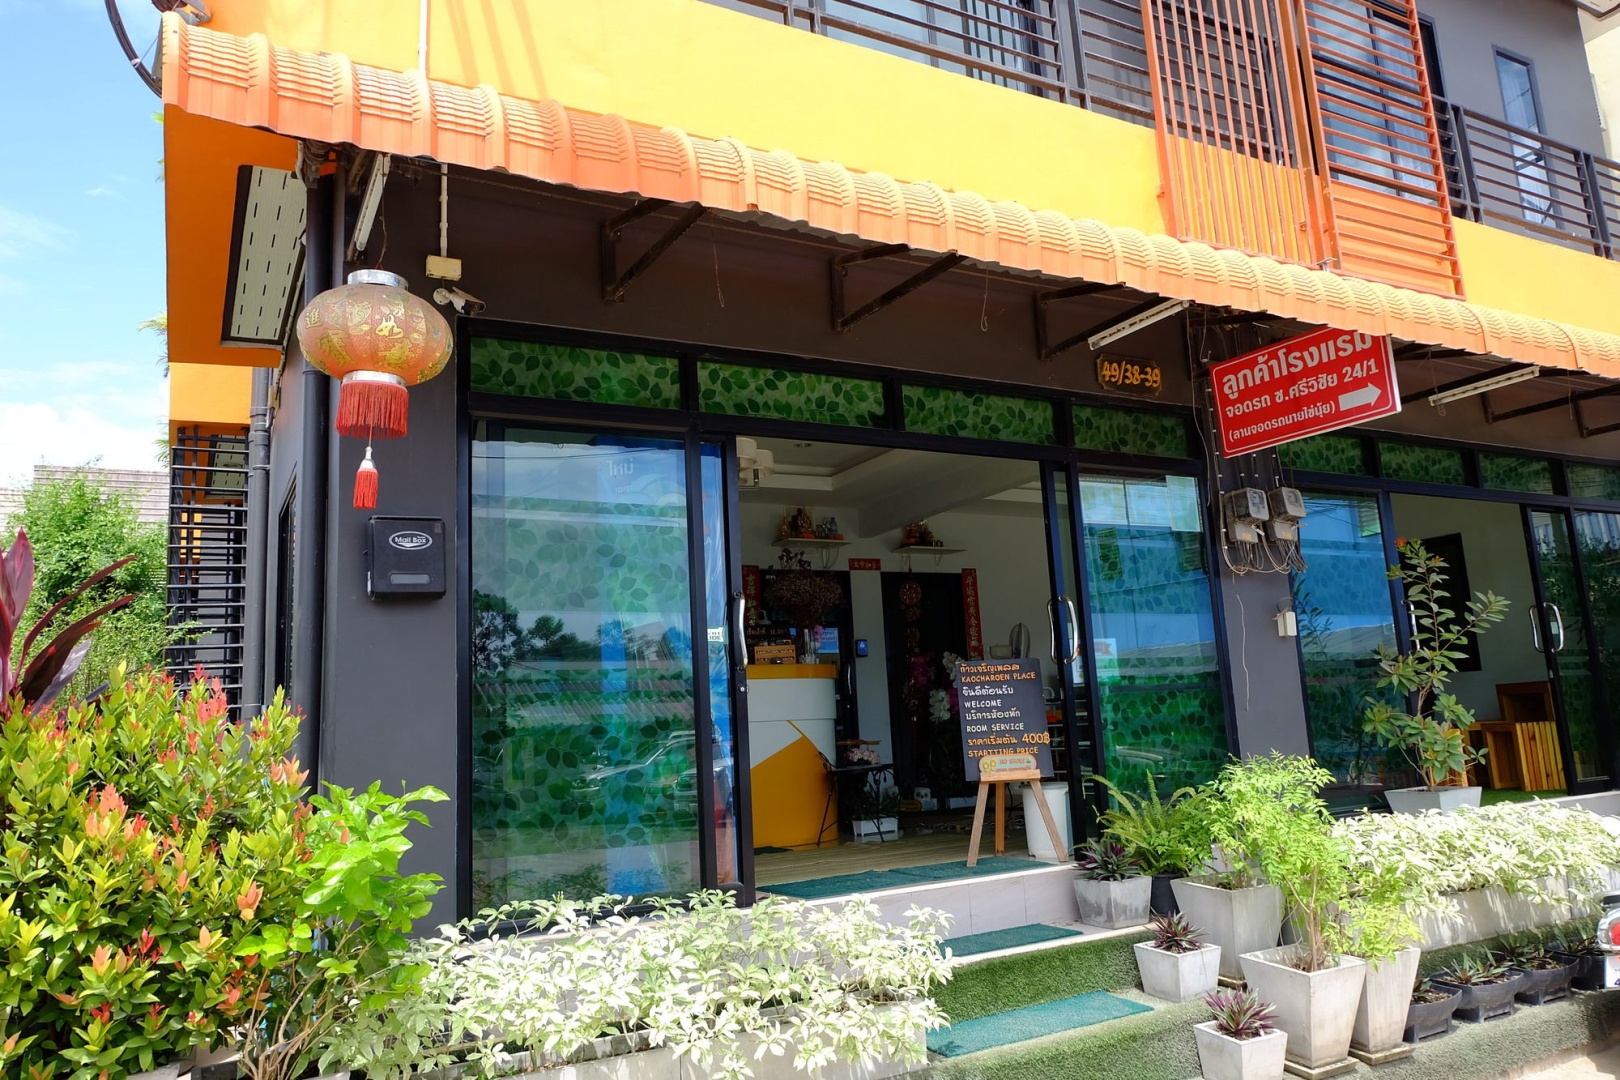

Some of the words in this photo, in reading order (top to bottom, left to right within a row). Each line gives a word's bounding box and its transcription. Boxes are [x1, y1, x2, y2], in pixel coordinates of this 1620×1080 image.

[1222, 332, 1373, 399] ลูกค้าโรงแรม
[1102, 361, 1161, 387] 49/38-39
[1225, 395, 1271, 418] จอดรถ
[1342, 358, 1379, 383] 24/1
[962, 673, 1010, 683] KAOCHAROEN
[1013, 671, 1036, 680] PLACE
[962, 684, 1014, 696] ยินดีต้อนรับ
[964, 699, 1002, 708] WELCOME
[965, 707, 1021, 720] บริการห้องพัก
[966, 724, 988, 732] ROOM
[991, 722, 1025, 731] SERVICE
[1016, 746, 1039, 755] PRICE
